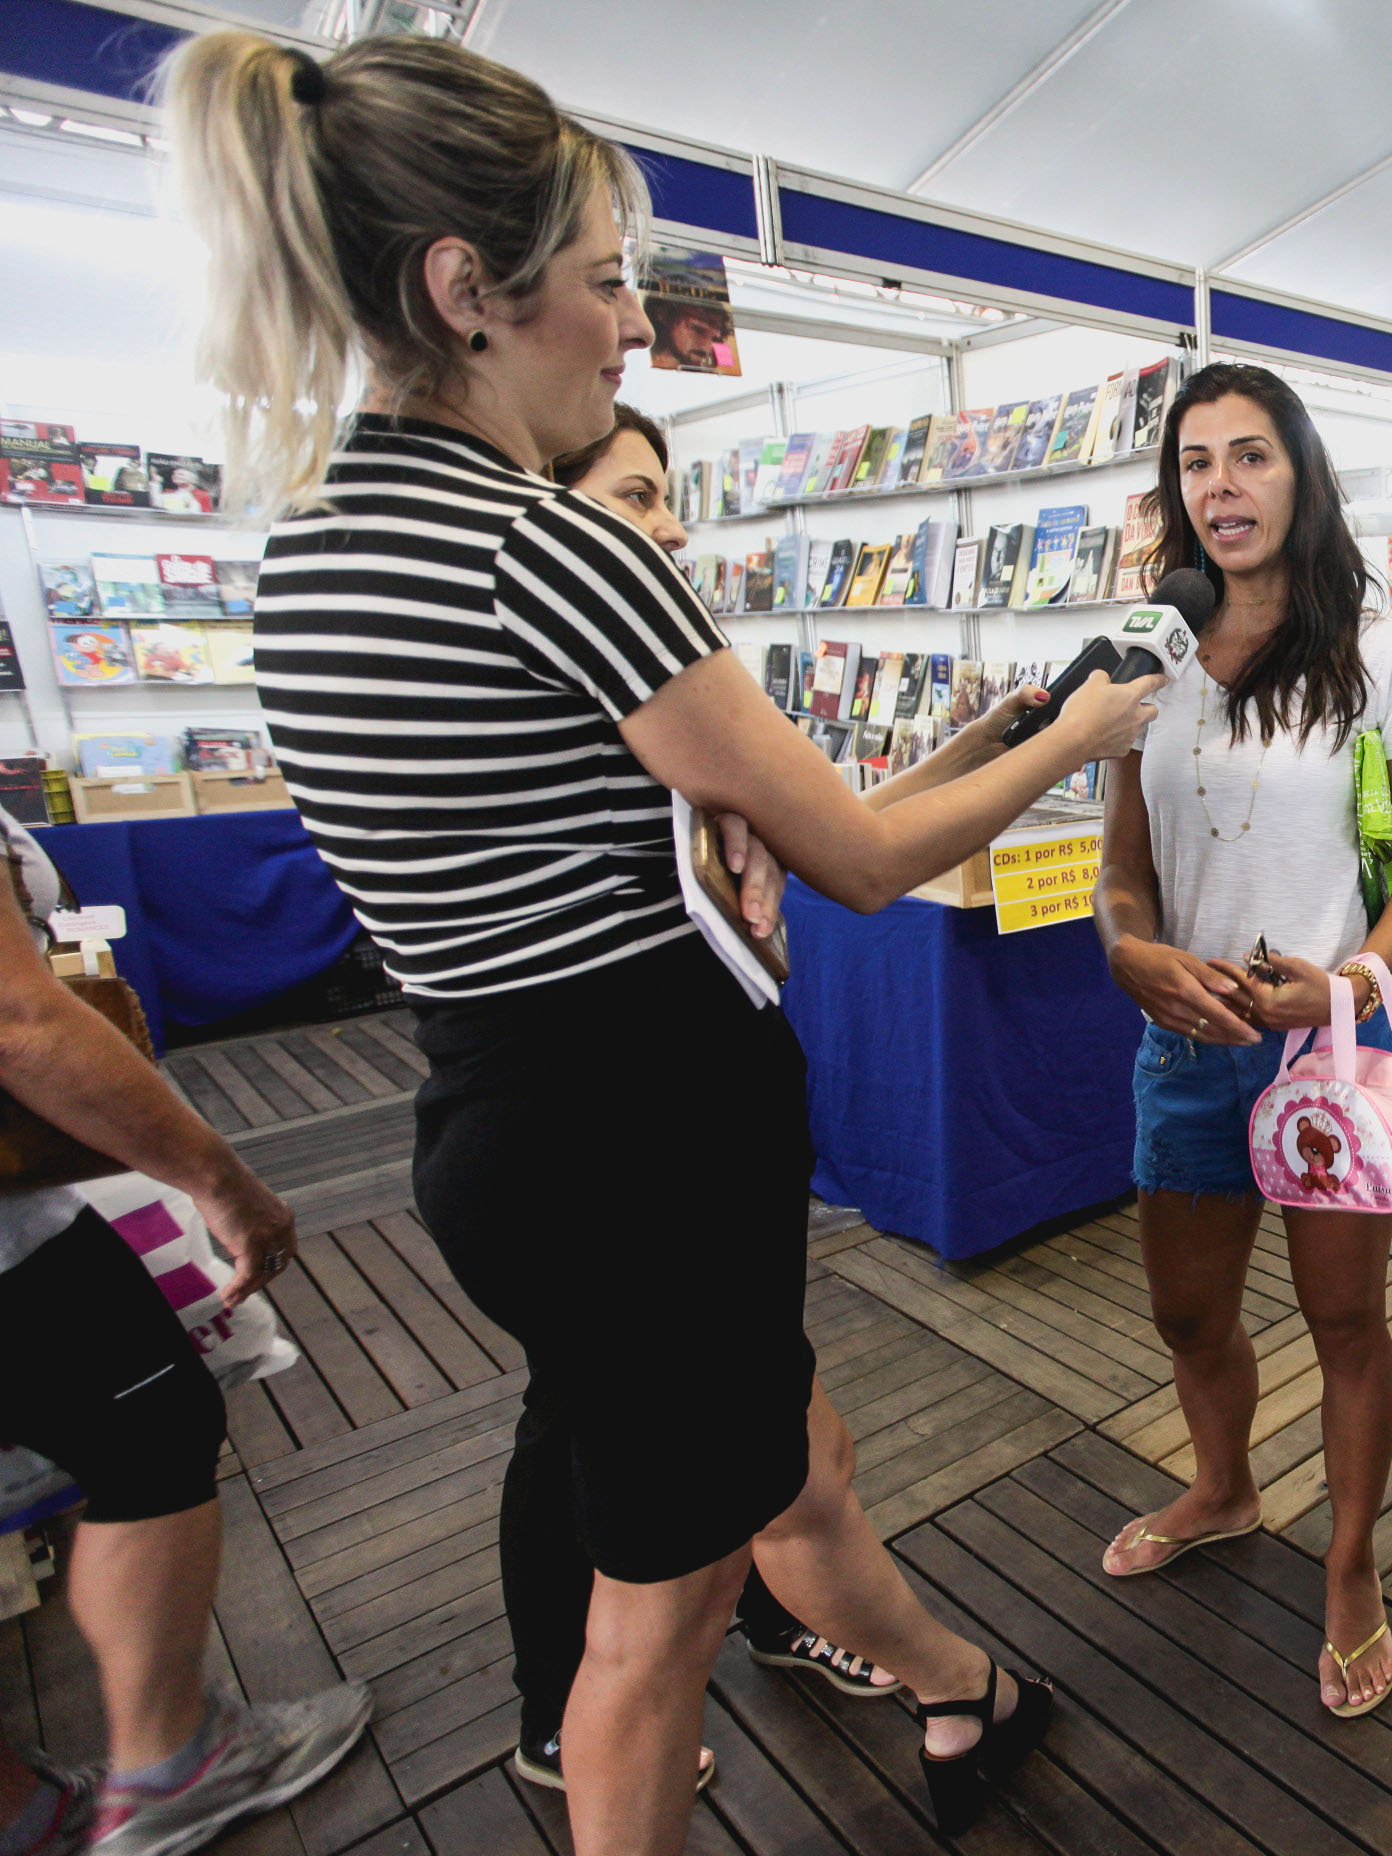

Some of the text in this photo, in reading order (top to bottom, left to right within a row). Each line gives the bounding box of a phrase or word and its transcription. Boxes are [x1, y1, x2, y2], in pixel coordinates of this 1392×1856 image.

[994, 852, 1021, 866] CDs:
[1025, 850, 1031, 861] 1
[1035, 848, 1055, 862] por
[1059, 842, 1073, 856] R$
[1027, 866, 1100, 890] 2 por R$ 8,0
[1030, 905, 1037, 917] 3
[1041, 903, 1061, 917] por
[1064, 896, 1079, 910] R$
